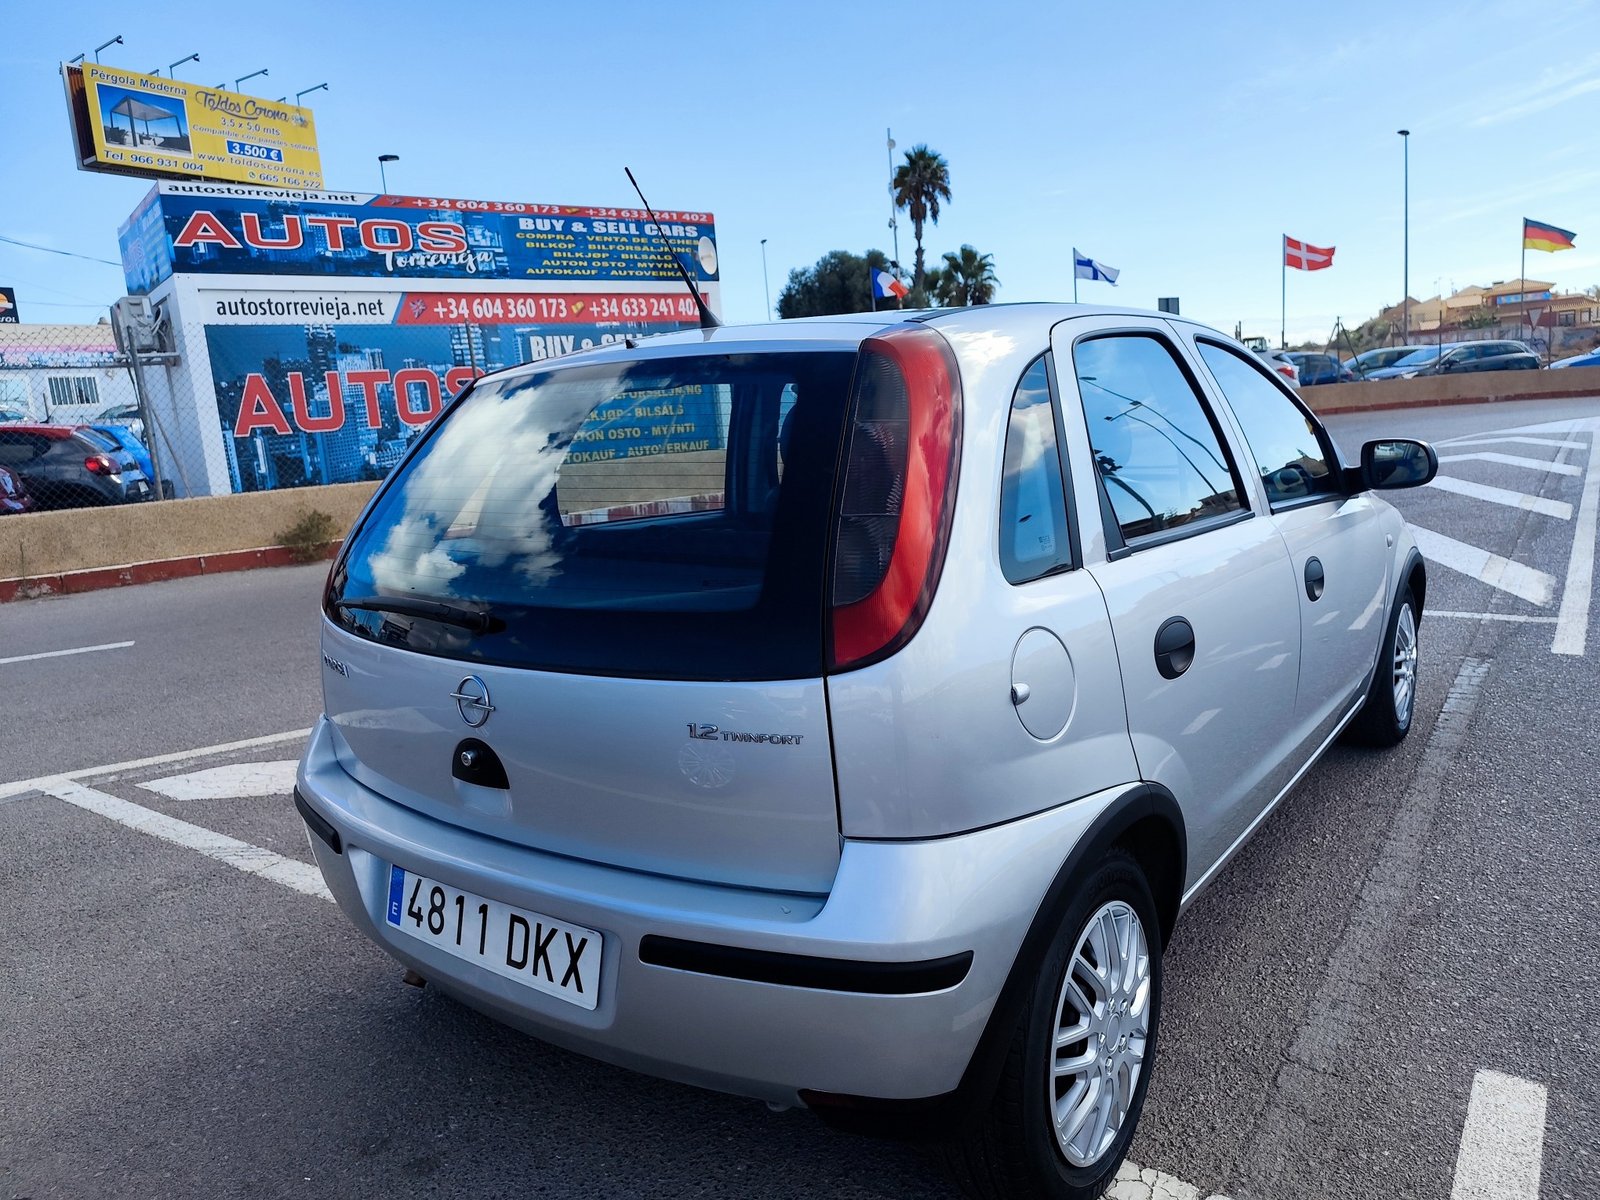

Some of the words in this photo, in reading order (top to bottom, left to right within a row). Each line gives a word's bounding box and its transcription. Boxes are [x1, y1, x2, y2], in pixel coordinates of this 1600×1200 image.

[91, 69, 135, 84] Pérgola
[140, 79, 187, 95] Moderna
[195, 90, 246, 115] Toldos
[244, 100, 289, 122] Corona
[192, 124, 239, 138] Compatible
[232, 142, 267, 158] 3.500
[270, 150, 279, 160] €
[130, 154, 153, 164] 966
[157, 158, 178, 168] 931
[182, 161, 204, 171] 004
[259, 173, 279, 182] 665
[283, 176, 300, 186] 166
[303, 179, 321, 189] 572
[168, 184, 357, 202] autostorrevieja.net
[413, 198, 451, 208] +34
[455, 200, 489, 210] 604
[494, 202, 525, 212] 360
[530, 204, 560, 214] 173
[585, 207, 617, 217] +34
[621, 209, 648, 219] 633
[653, 211, 678, 220] 241
[682, 213, 707, 222] 402
[173, 210, 467, 253] AUTOS
[516, 232, 574, 240] COMPRA
[518, 217, 565, 231] BUY
[571, 221, 588, 233] &
[592, 221, 640, 235] SELL
[644, 223, 698, 237] CARS
[378, 250, 493, 273] Torrevieja
[542, 259, 588, 267] AUTON
[216, 296, 385, 320] autostorrevieja.net
[433, 298, 469, 318] +34
[473, 298, 504, 318] 604
[506, 298, 536, 318] 360
[540, 298, 567, 318] 173
[590, 298, 619, 317] +34
[621, 298, 648, 317] 633
[650, 298, 674, 316] 241
[608, 427, 641, 439] OSTO
[720, 731, 803, 745] TWINPORT
[391, 901, 398, 915] E
[407, 878, 489, 956] 4811
[506, 913, 589, 994] DKX
